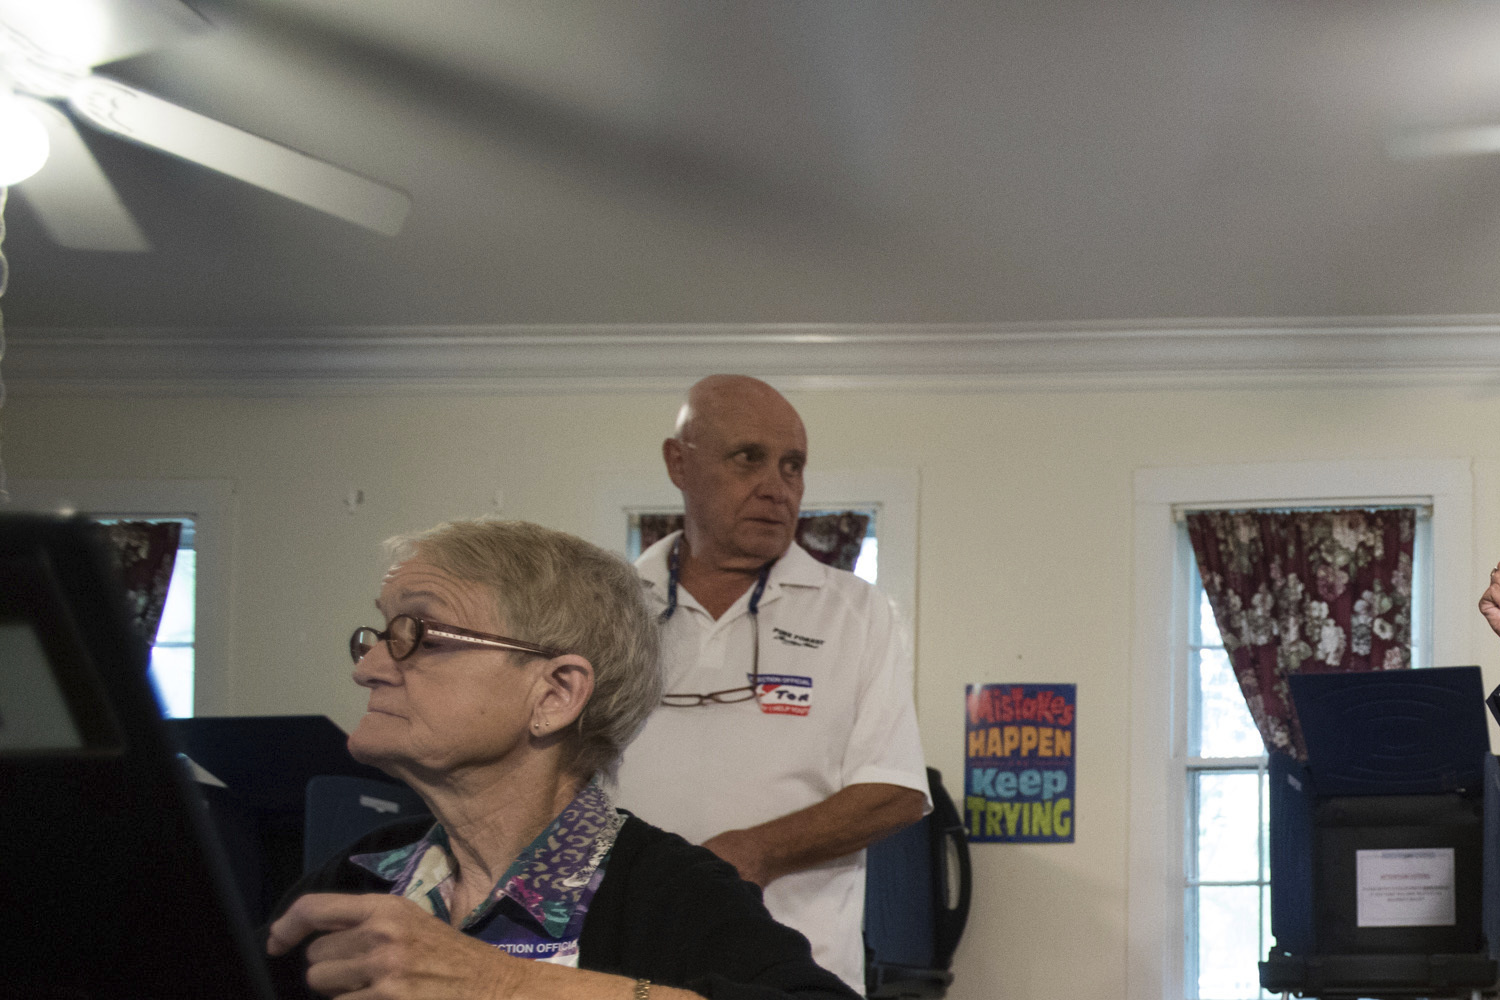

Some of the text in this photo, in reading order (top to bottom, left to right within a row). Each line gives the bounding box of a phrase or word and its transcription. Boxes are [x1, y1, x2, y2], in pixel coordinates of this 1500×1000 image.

[968, 726, 1072, 758] HAPPEN
[972, 768, 1068, 800] Keep
[966, 796, 1072, 837] TRYING
[492, 944, 534, 954] CTION
